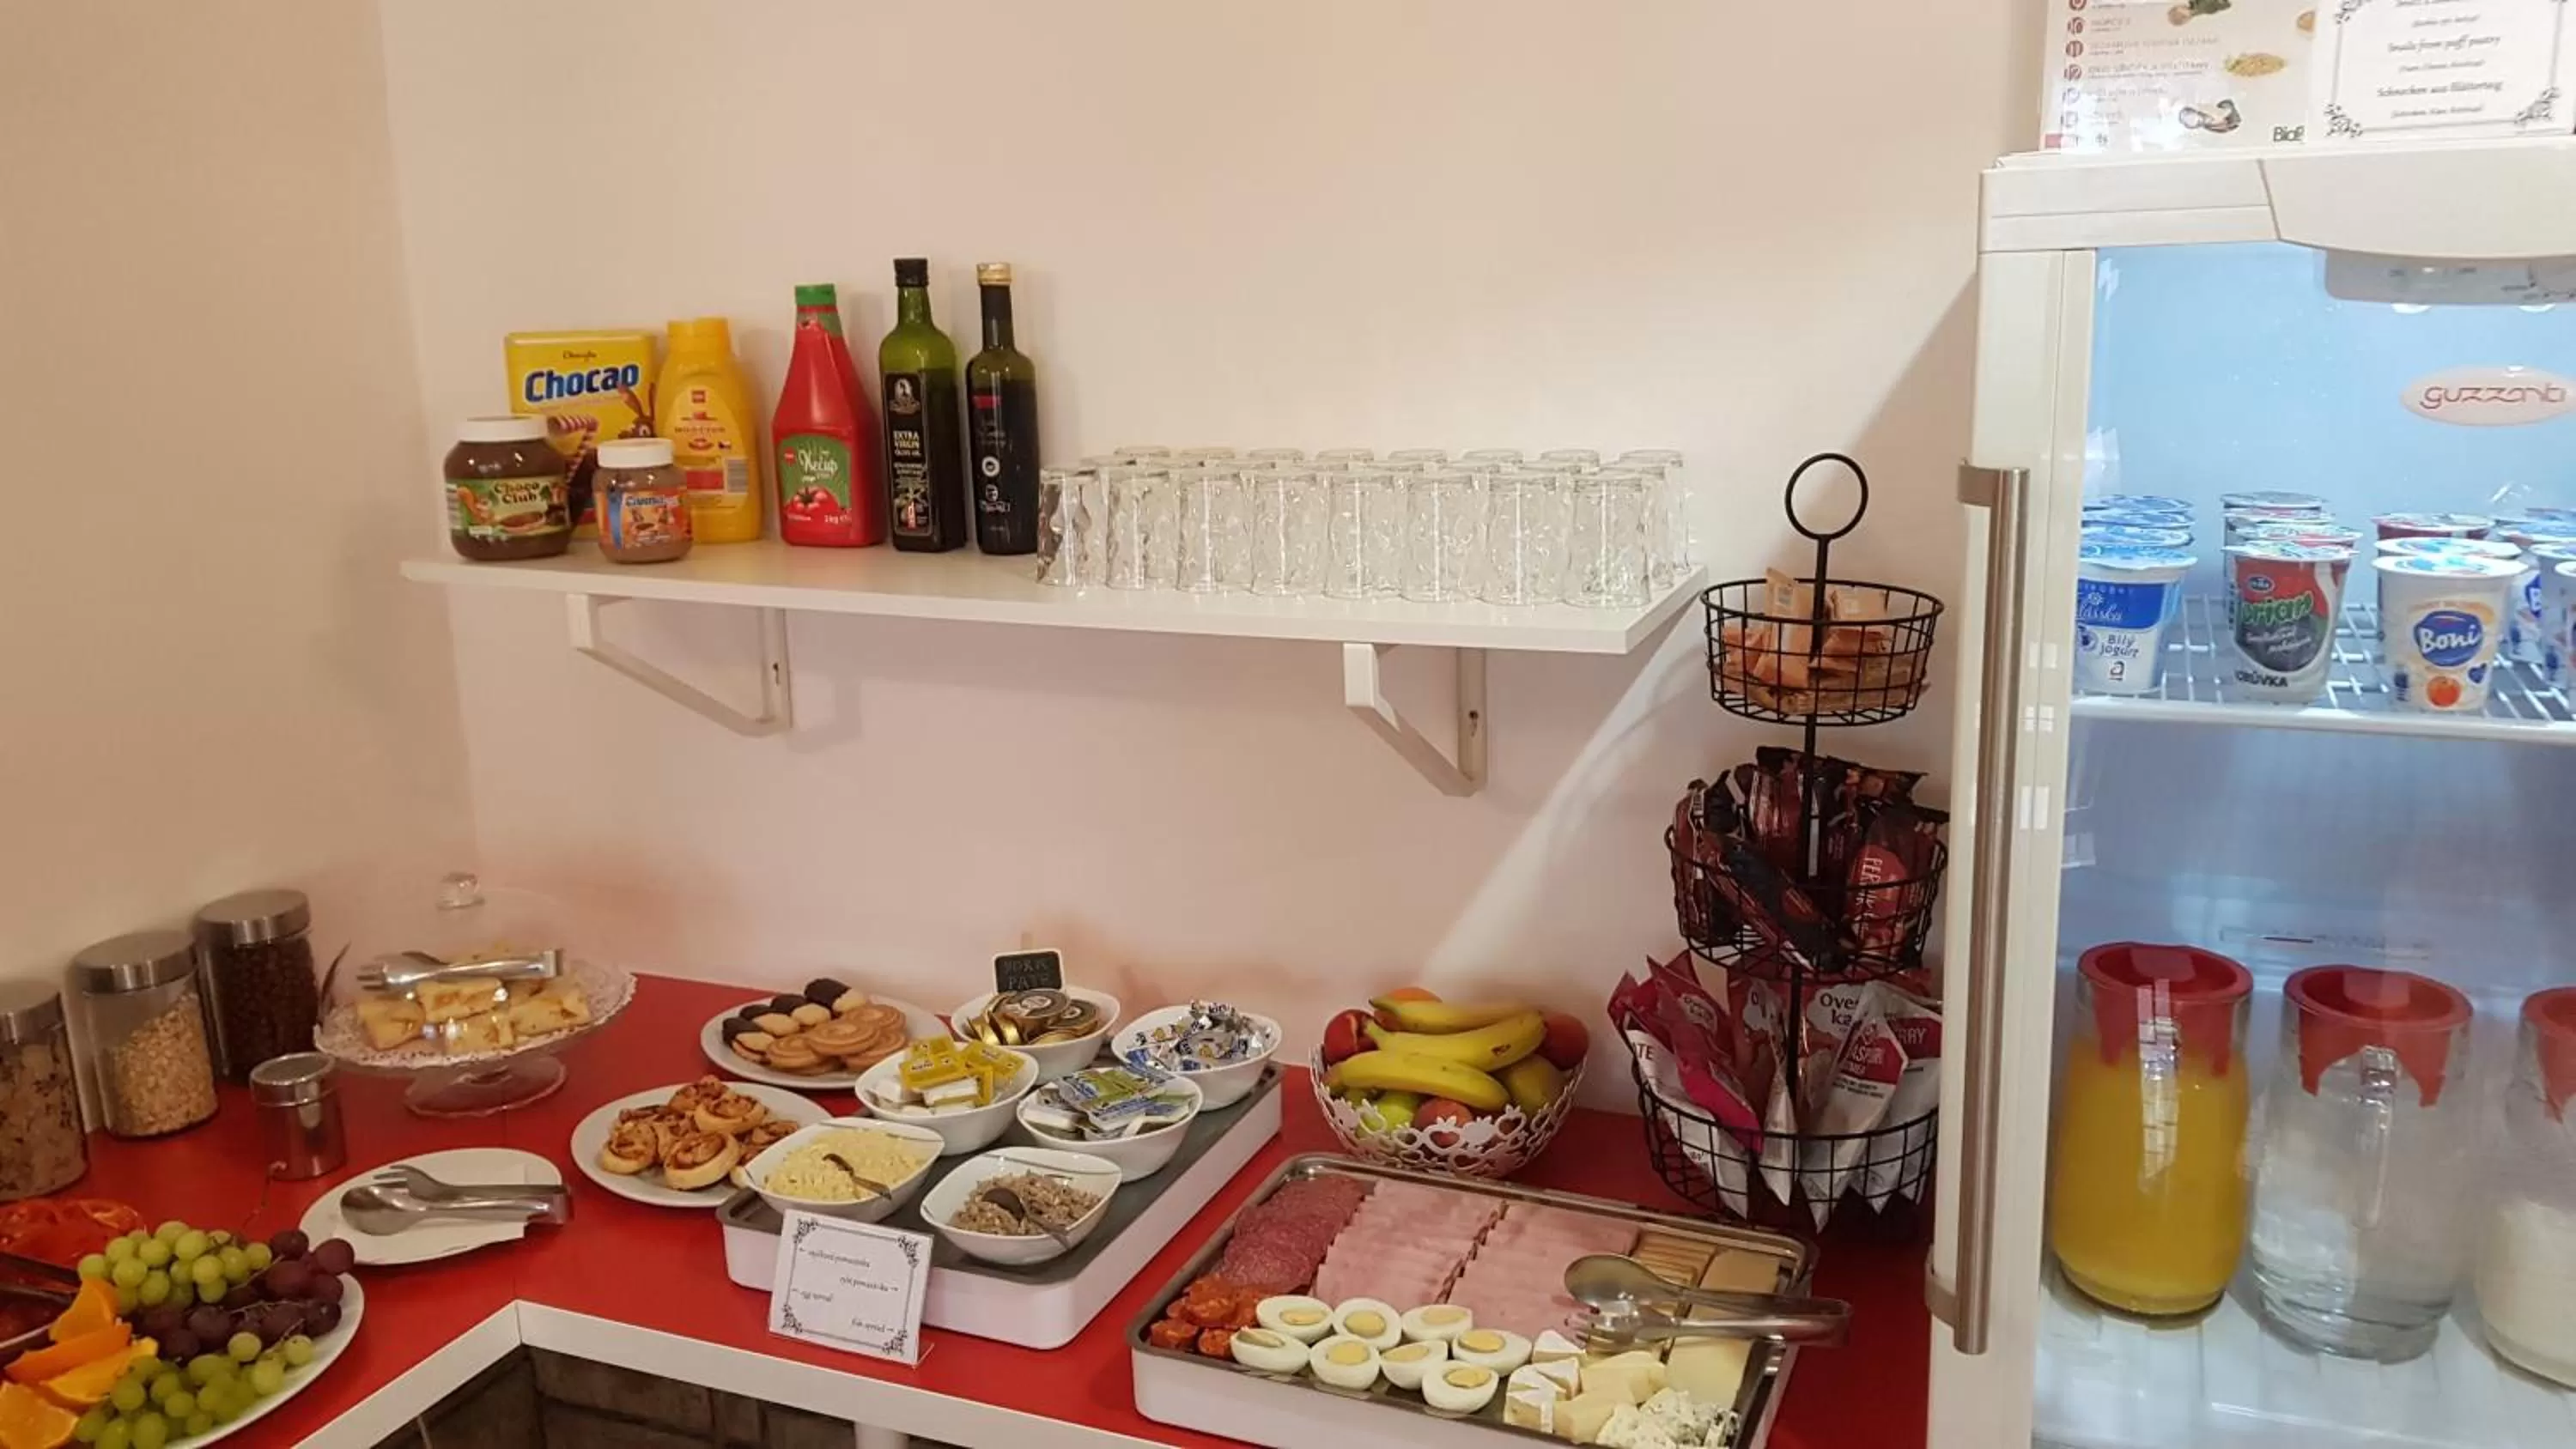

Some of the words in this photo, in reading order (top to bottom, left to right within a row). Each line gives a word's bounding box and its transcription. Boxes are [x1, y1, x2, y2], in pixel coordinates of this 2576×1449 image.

[524, 362, 641, 403] Chocao
[893, 430, 920, 440] EXTRA
[894, 440, 920, 449] VIRGIN
[493, 481, 541, 495] Choco
[501, 492, 538, 505] Club
[2418, 623, 2482, 655] Boni
